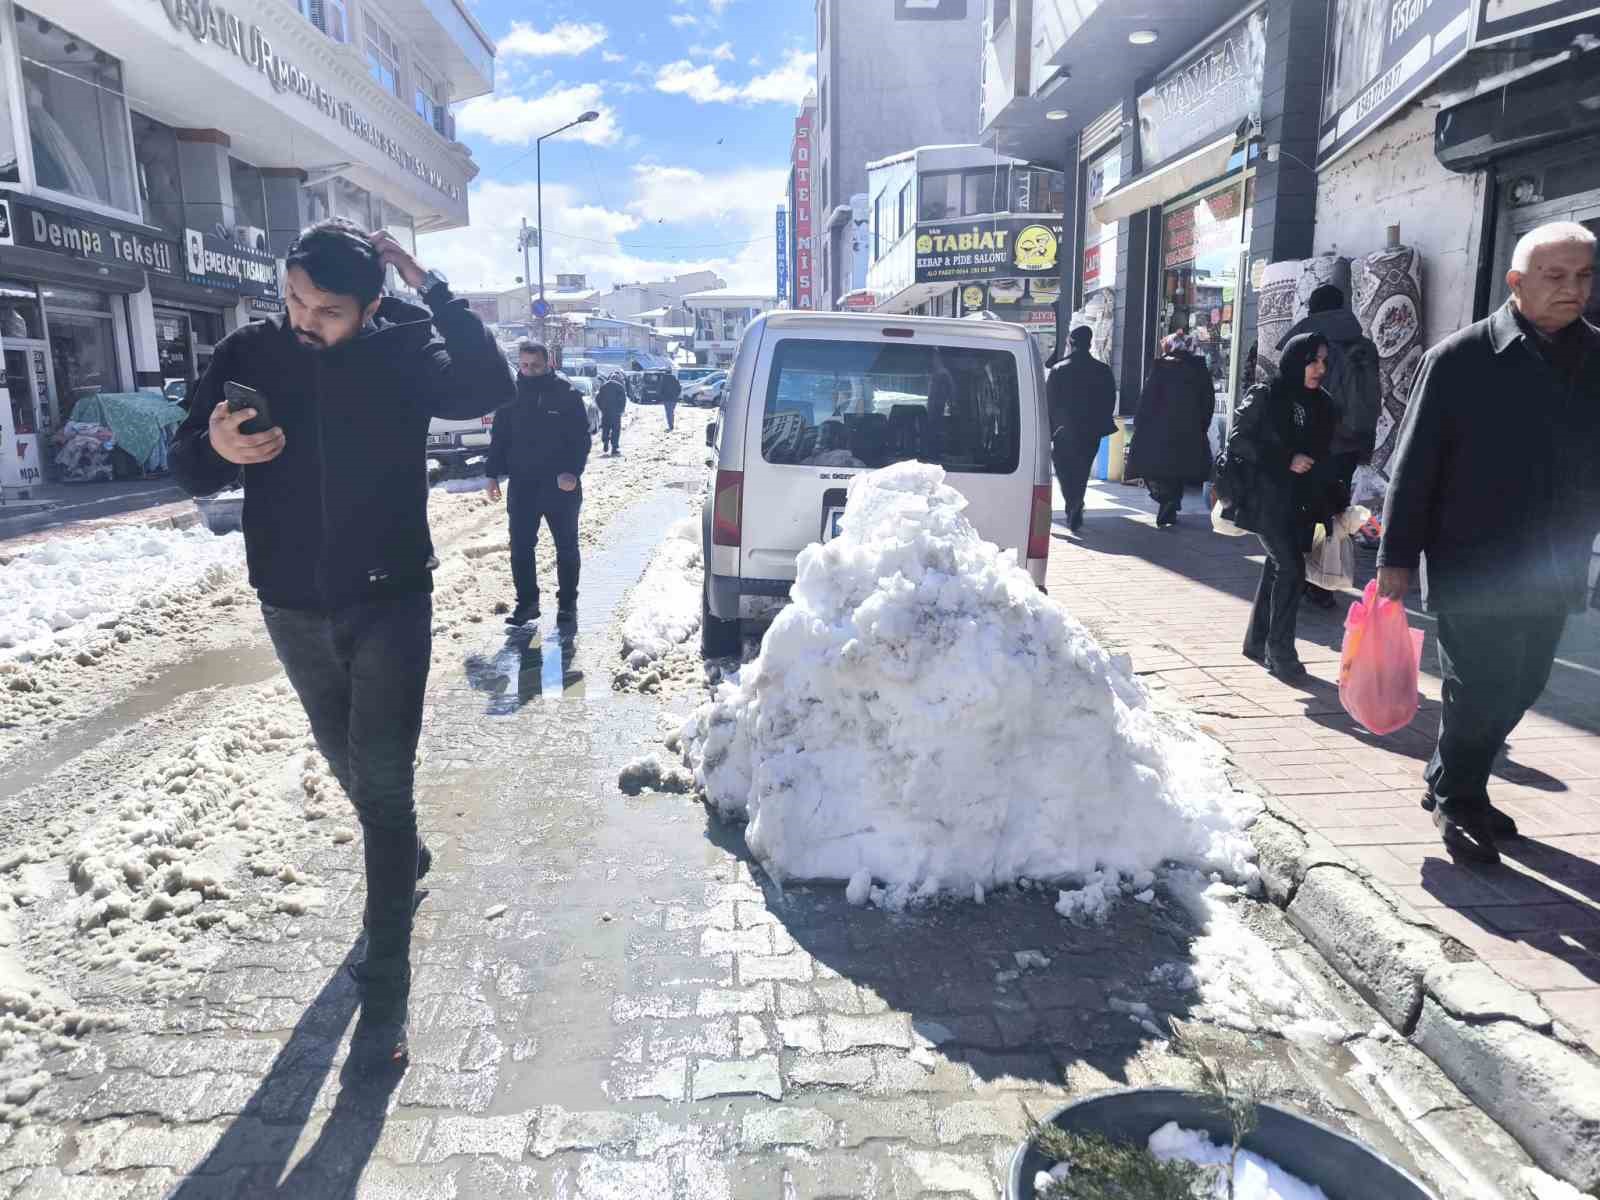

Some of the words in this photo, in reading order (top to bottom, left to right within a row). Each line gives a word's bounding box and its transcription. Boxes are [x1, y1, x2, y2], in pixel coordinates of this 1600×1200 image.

[32, 211, 102, 257] Dempa
[110, 231, 171, 270] Tekstil
[933, 227, 1009, 253] TABİAT
[204, 250, 227, 275] EMEK
[917, 256, 943, 268] KEBAP
[944, 257, 951, 266] &
[953, 254, 973, 266] PİDE
[974, 252, 1007, 265] SALONU
